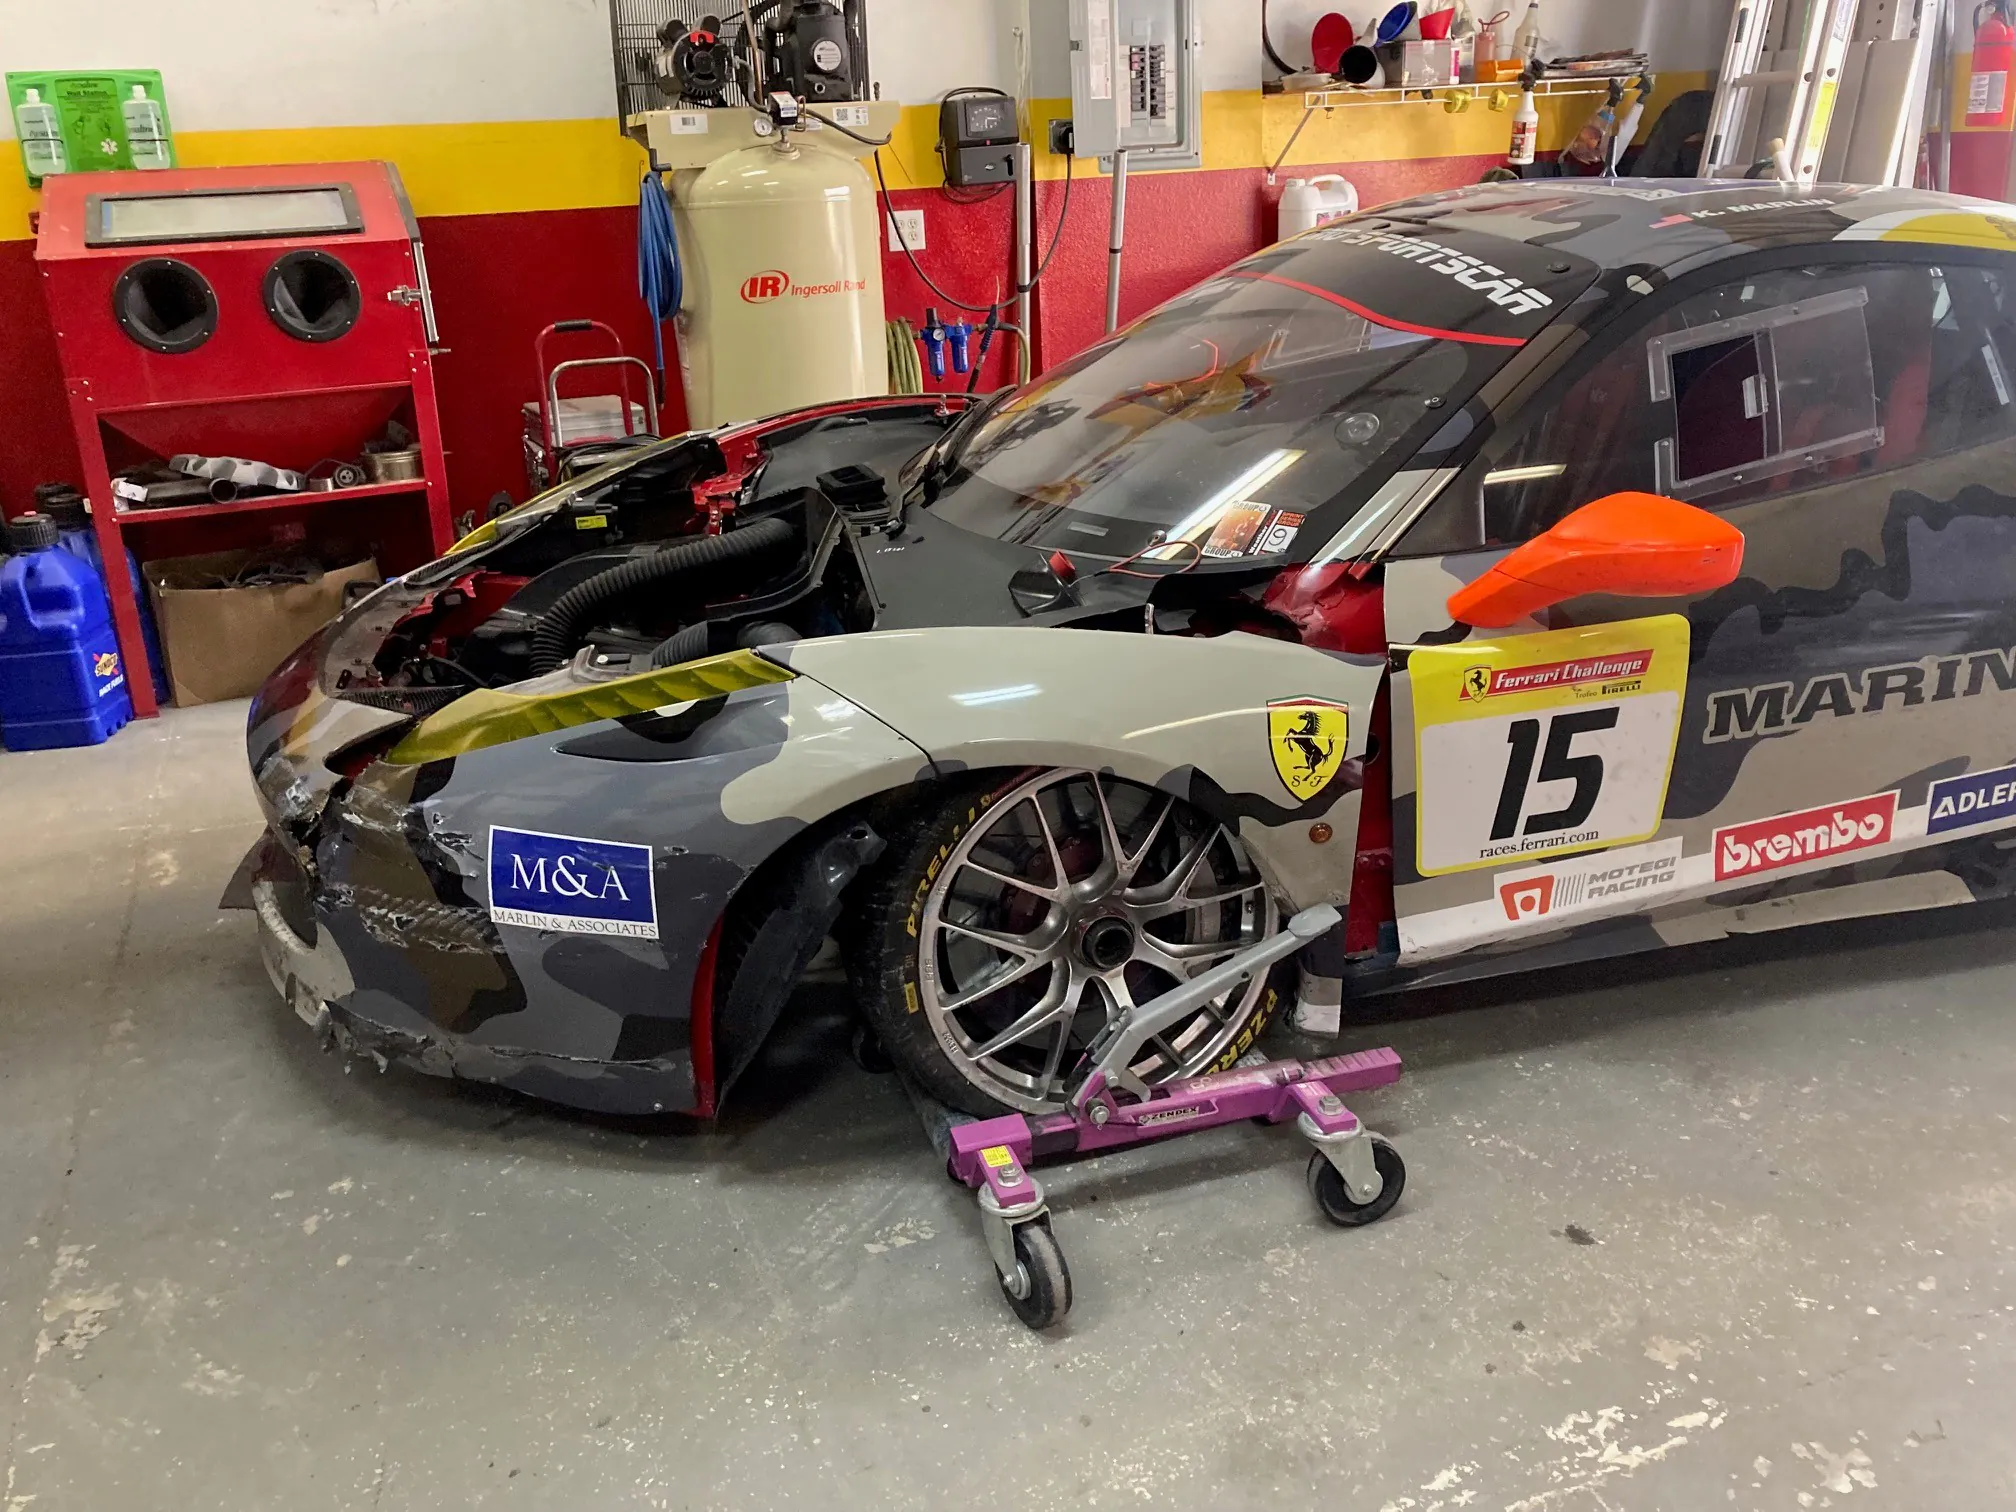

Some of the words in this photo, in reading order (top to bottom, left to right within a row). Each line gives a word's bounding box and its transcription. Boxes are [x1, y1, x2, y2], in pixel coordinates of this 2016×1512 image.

[1691, 209, 1726, 218] K.
[1726, 198, 1836, 212] MARLIN
[1340, 231, 1554, 316] SPORTSCAR
[791, 280, 842, 299] Ingersoll
[844, 278, 866, 292] Rand
[1204, 547, 1232, 557] GROUP
[1268, 528, 1287, 547] 9
[1496, 667, 1560, 689] Ferrari
[1562, 658, 1643, 680] Challenge
[1575, 690, 1598, 698] Trofeo
[1601, 680, 1641, 695] PIRELLI
[1489, 706, 1620, 841] 15
[1479, 830, 1600, 859] races.ferrari.com
[1723, 811, 1884, 874] brembo
[510, 853, 631, 902] M&A
[1587, 870, 1677, 900] RACING
[1588, 856, 1678, 885] MOTEGI
[493, 909, 547, 929] MARLIN
[551, 918, 563, 930] &
[567, 919, 658, 938] ASSOCIATES
[1151, 1105, 1197, 1120] ZENDEX
